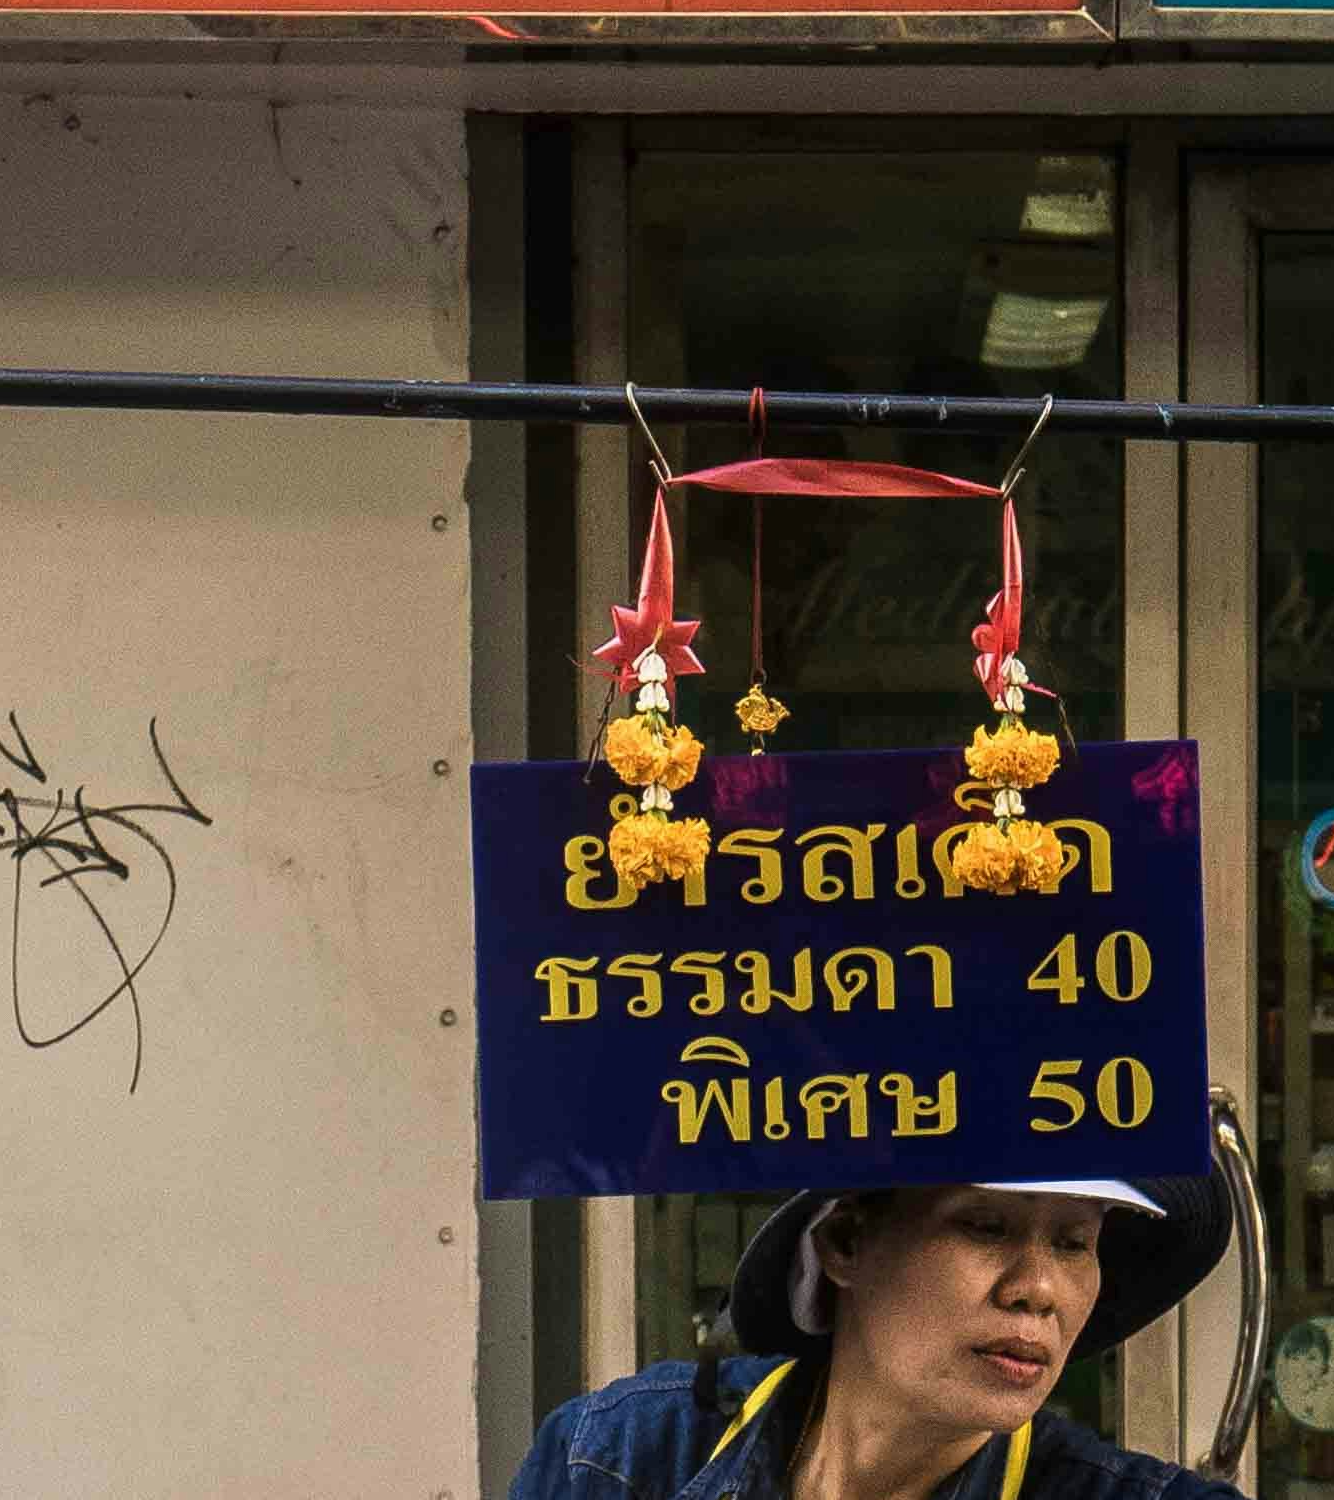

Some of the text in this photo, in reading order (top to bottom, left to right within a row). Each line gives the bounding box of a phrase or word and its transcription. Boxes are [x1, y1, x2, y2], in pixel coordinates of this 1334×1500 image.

[534, 929, 1153, 1023] ธรรมดา 40
[661, 1036, 1155, 1146] พิเศษ 50
